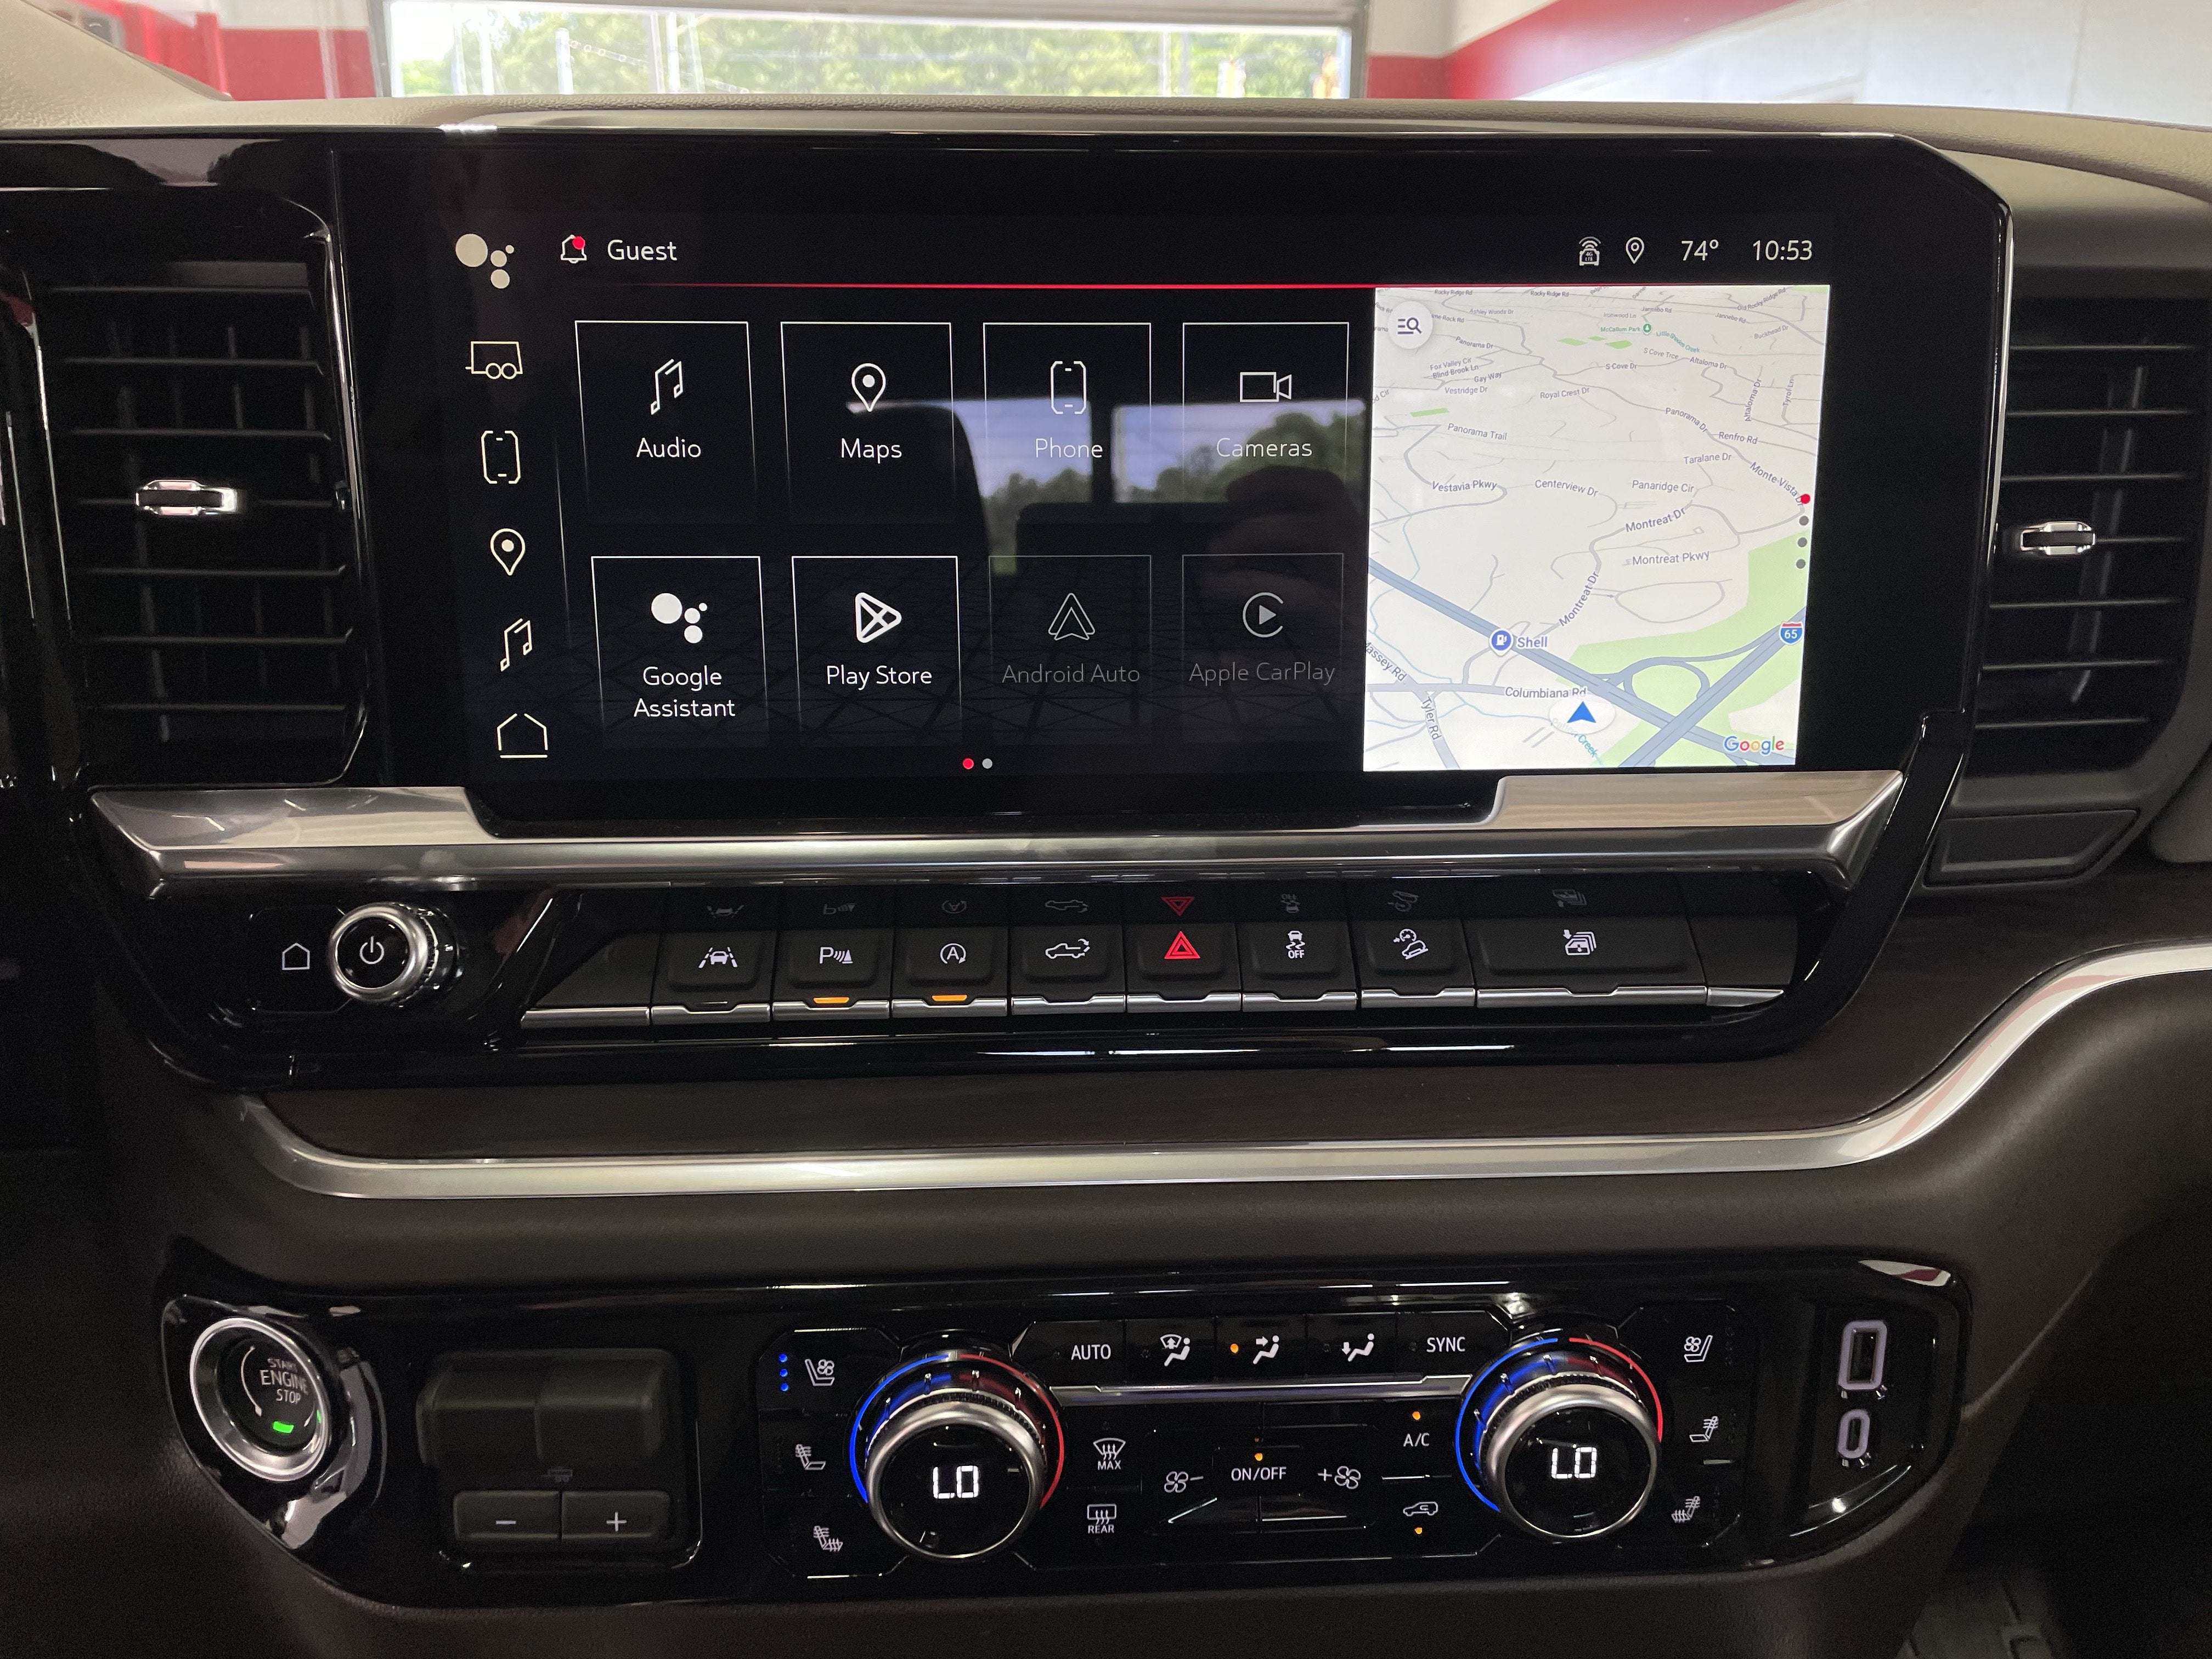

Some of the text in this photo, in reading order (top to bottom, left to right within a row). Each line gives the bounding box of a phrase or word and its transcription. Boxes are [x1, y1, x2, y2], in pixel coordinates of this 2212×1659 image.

[607, 240, 678, 261] Guest
[1752, 240, 1813, 261] 10:53
[1763, 293, 1778, 303] Ridge
[1715, 313, 1737, 321] Jannebo
[1754, 327, 1781, 339] Buckhead
[1456, 336, 1485, 348] Panorama
[1685, 345, 1700, 353] Creek
[1690, 357, 1718, 368] Altaloma
[1380, 388, 1390, 398] Cir
[1445, 387, 1478, 395] Vestridge
[1540, 387, 1590, 399] Royal Crest Dr
[1782, 379, 1795, 406] Tyrol Ln
[1743, 379, 1762, 421] Altaloma Dr
[1666, 407, 1707, 432] Panorama Dr
[1447, 423, 1508, 440] Panorama Trail
[1718, 431, 1758, 444] Renfro Rd
[636, 437, 701, 458] Audio
[840, 438, 902, 464] Maps
[1035, 438, 1103, 459] Phone
[1216, 437, 1313, 458] Cameras
[1684, 453, 1731, 464] Taralane Dr
[1432, 479, 1497, 493] Vestavia Pkwy
[1535, 479, 1598, 497] Centerview Dr
[1632, 479, 1694, 493] Panaridge Cir
[1750, 462, 1778, 483] Monte
[1779, 477, 1798, 497] Vista
[1625, 507, 1686, 532] Montreat Dr
[1632, 550, 1710, 565] Montreat Pkwy
[1559, 571, 1599, 627] Montreat Dr
[1517, 636, 1548, 648] Shell
[1784, 629, 1798, 639] 65
[642, 665, 723, 692] Google
[826, 665, 933, 691] Play Store
[1002, 663, 1141, 684] Android Auto
[1189, 661, 1336, 687] Apple CarPlay
[1391, 666, 1407, 681] Rd
[1505, 686, 1587, 698] Columbiana Rd
[633, 698, 736, 718] Assistant
[1421, 696, 1442, 741] Tyler Rd
[1578, 735, 1598, 758] Creek
[1724, 735, 1785, 755] Google
[1288, 950, 1305, 959] OFF
[1071, 1344, 1111, 1361] AUTO
[1426, 1336, 1466, 1353] SYNC
[259, 1369, 308, 1395] ENGINE
[275, 1389, 301, 1404] STOP
[1403, 1432, 1430, 1448] A/C
[1097, 1460, 1122, 1471] MAX
[1231, 1466, 1286, 1481] ON/OFF
[1087, 1525, 1115, 1534] REAR
